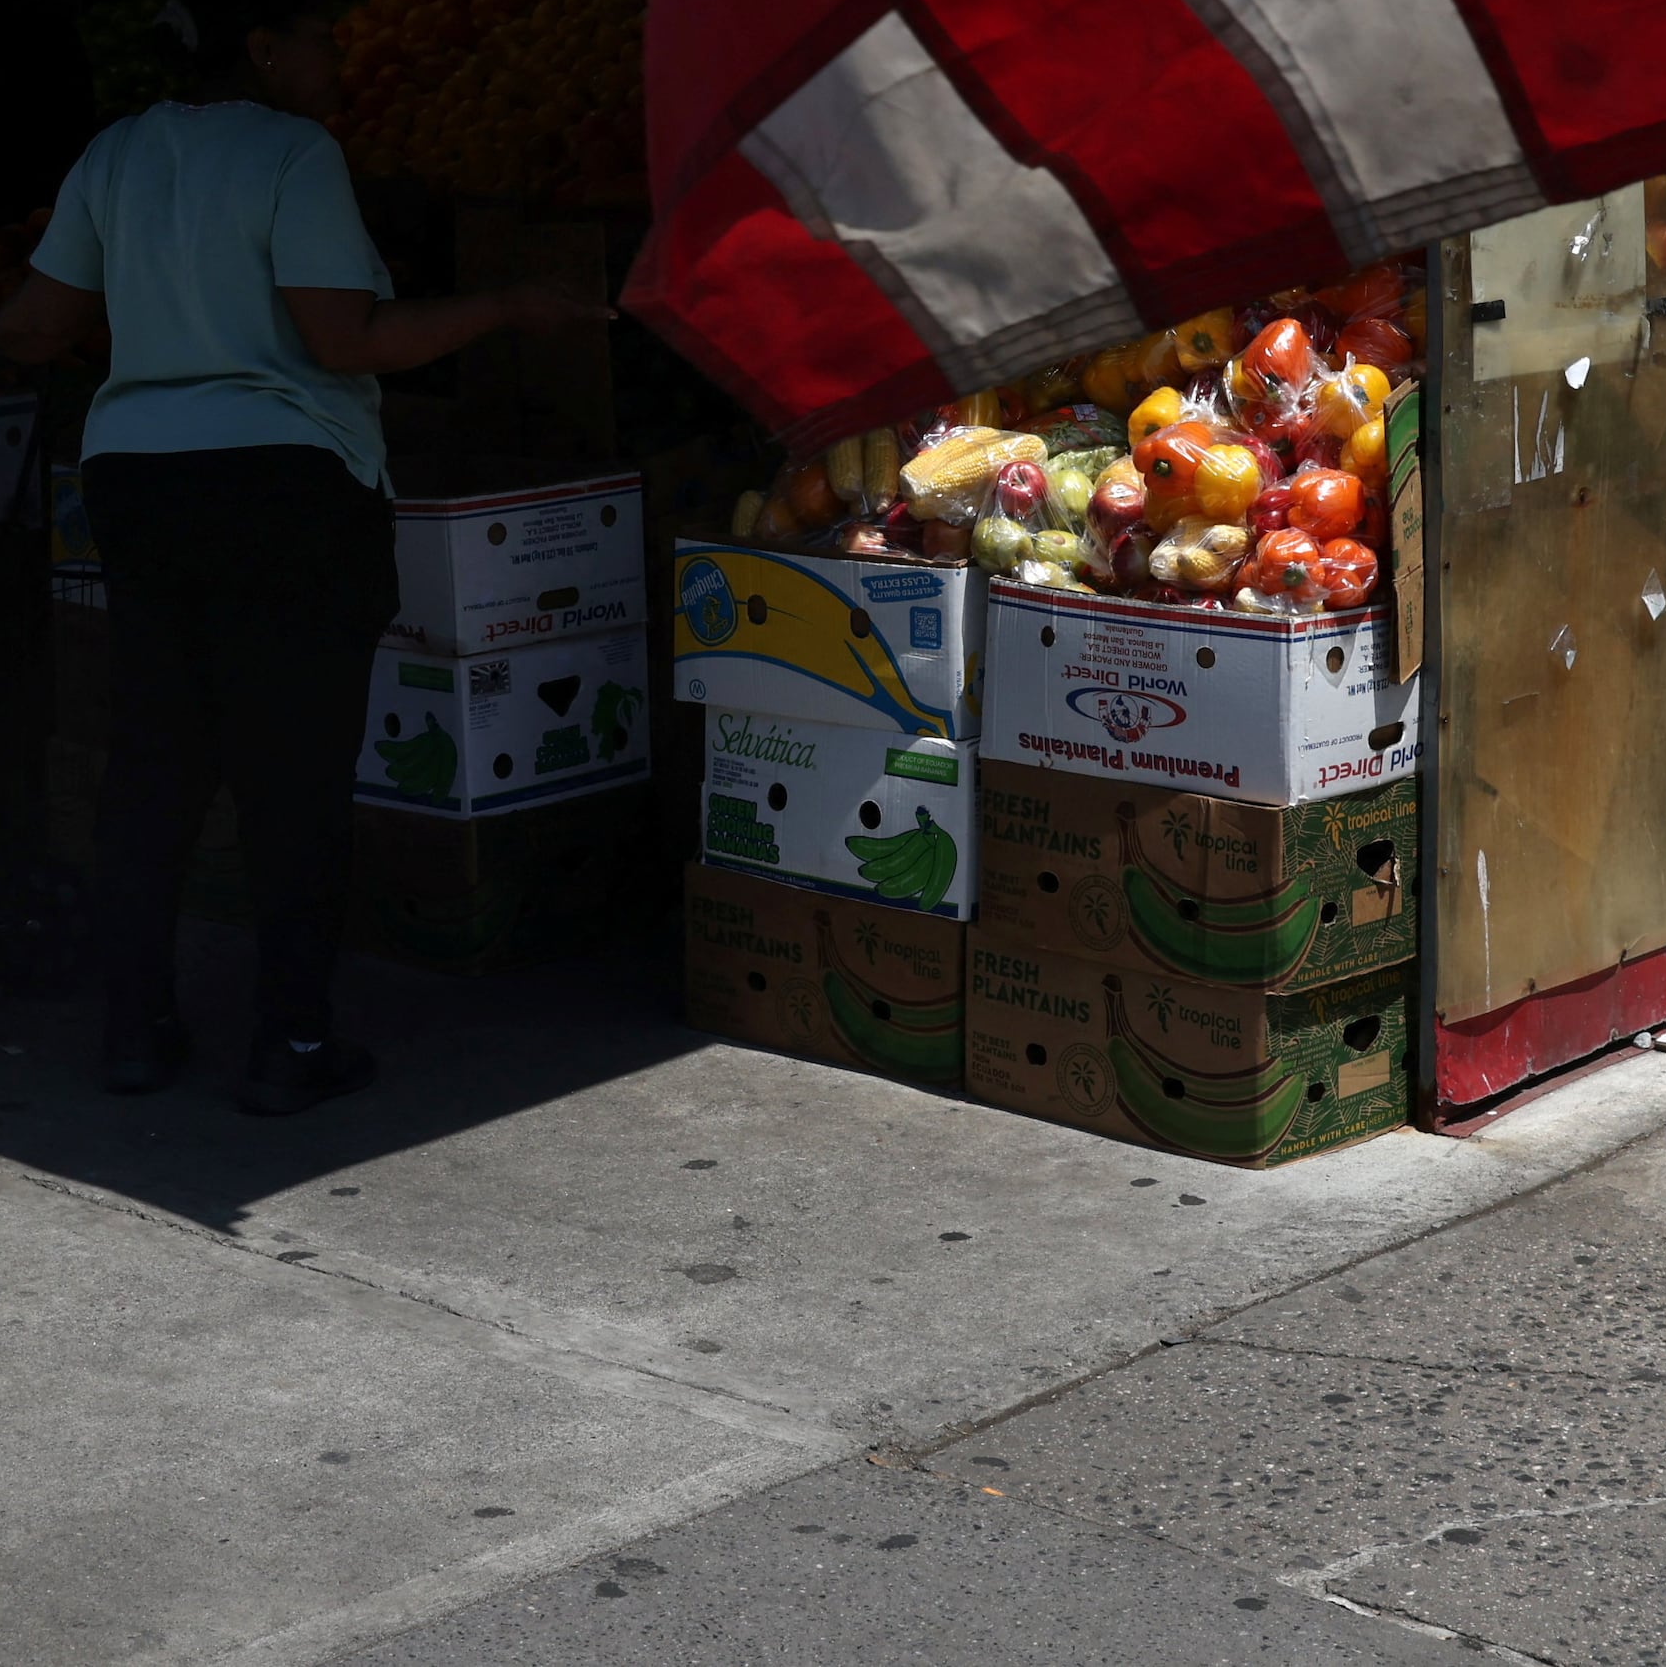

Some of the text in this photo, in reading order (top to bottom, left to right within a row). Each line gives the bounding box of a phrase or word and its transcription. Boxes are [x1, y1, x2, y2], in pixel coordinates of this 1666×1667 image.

[681, 568, 725, 606] Chiquita
[870, 576, 930, 590] CLASS EXTRA
[872, 586, 935, 599] SELECTED QUALITY
[487, 600, 627, 642] World Direct
[1083, 632, 1109, 644] Marcos
[1101, 644, 1130, 656] DIRECT
[1110, 636, 1125, 646] San
[1155, 642, 1165, 651] La
[1079, 652, 1168, 672] GROWER AND PACKER:
[1131, 648, 1161, 660] WORLD
[1063, 664, 1188, 697] World Direct
[1356, 682, 1366, 694] Net
[712, 713, 815, 769] Selvática
[1330, 737, 1338, 746] OF
[1338, 733, 1363, 745] PRODUCT
[1018, 732, 1240, 788] Premium Plantains
[1319, 755, 1383, 788] Direct
[982, 789, 1050, 824] FRESH
[1347, 806, 1392, 830] tropical
[1395, 800, 1417, 818] line
[982, 813, 1103, 861] PLANTAINS
[1195, 831, 1259, 856] tropical
[1225, 853, 1258, 874] line
[690, 896, 754, 927] FRESH
[690, 919, 803, 964] PLANTAINS
[884, 939, 941, 964] tropical
[912, 958, 941, 980] line
[972, 949, 1040, 984] FRESH
[1297, 951, 1378, 982] HANDLE WITH CARE
[972, 974, 1091, 1024] PLANTAINS
[1331, 976, 1375, 1004] tropical
[1179, 1005, 1242, 1034] tropical
[972, 1041, 1018, 1062] PLANTAINS
[1210, 1029, 1242, 1050] line
[972, 1061, 1011, 1080] ECUADOR
[1280, 1139, 1316, 1155] HANDLE
[1318, 1129, 1342, 1145] WITH
[1343, 1120, 1366, 1137] CARE
